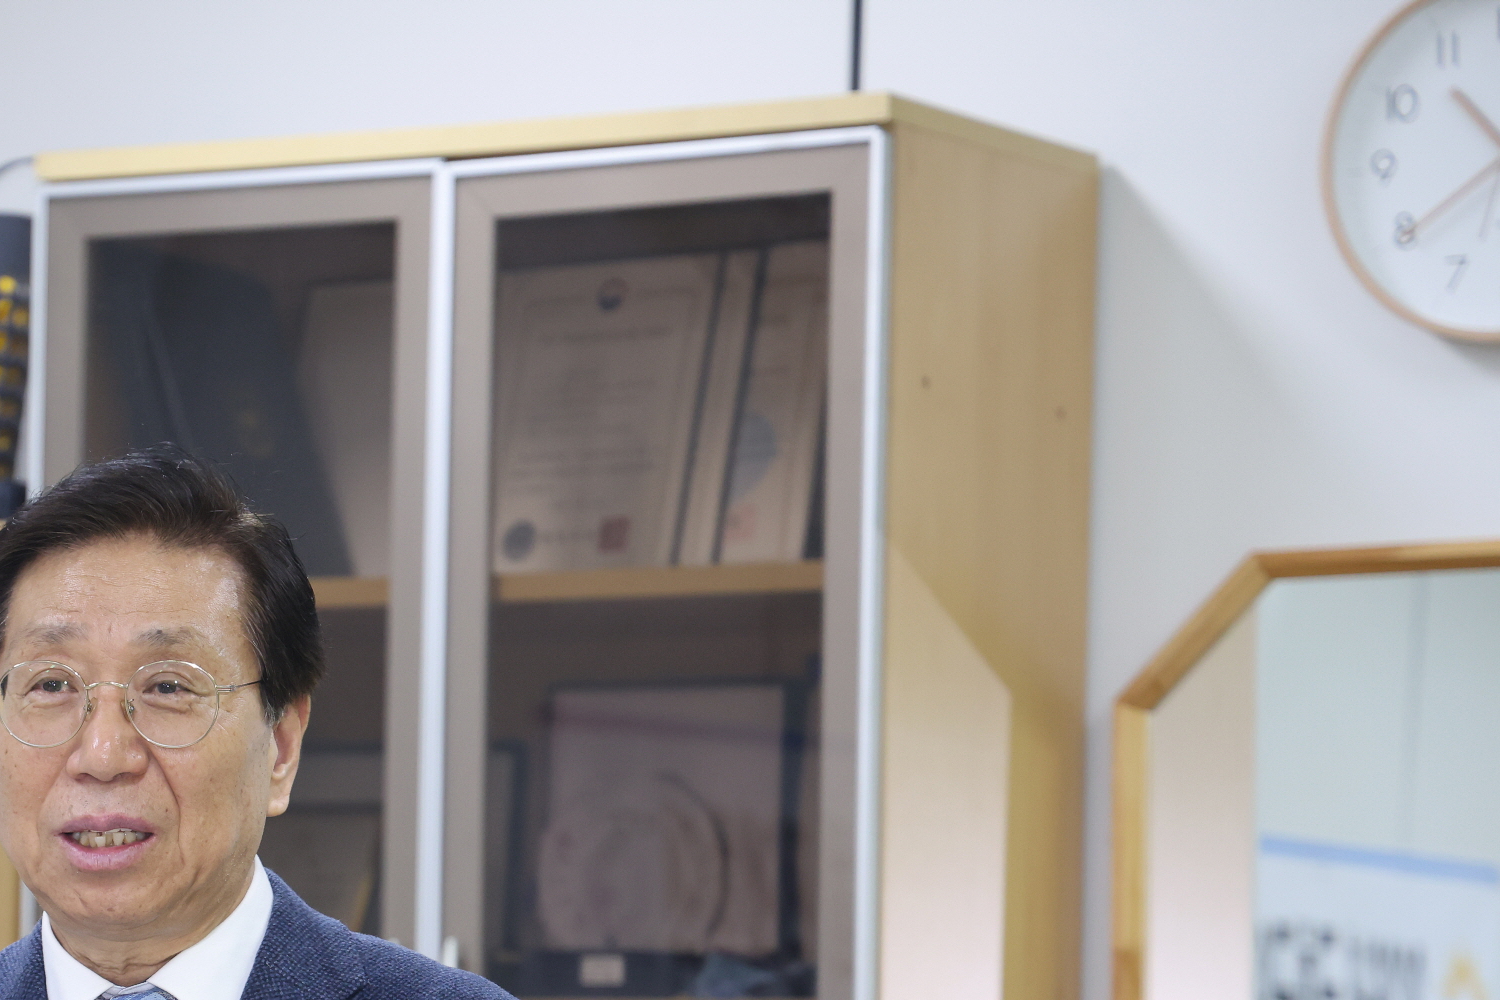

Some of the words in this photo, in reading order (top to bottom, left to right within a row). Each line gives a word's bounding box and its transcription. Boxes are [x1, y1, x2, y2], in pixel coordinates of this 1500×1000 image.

[1435, 29, 1460, 69] 11
[1385, 82, 1420, 124] 10
[1370, 147, 1397, 185] 9
[1393, 209, 1419, 251] 8
[1444, 252, 1470, 294] 7
